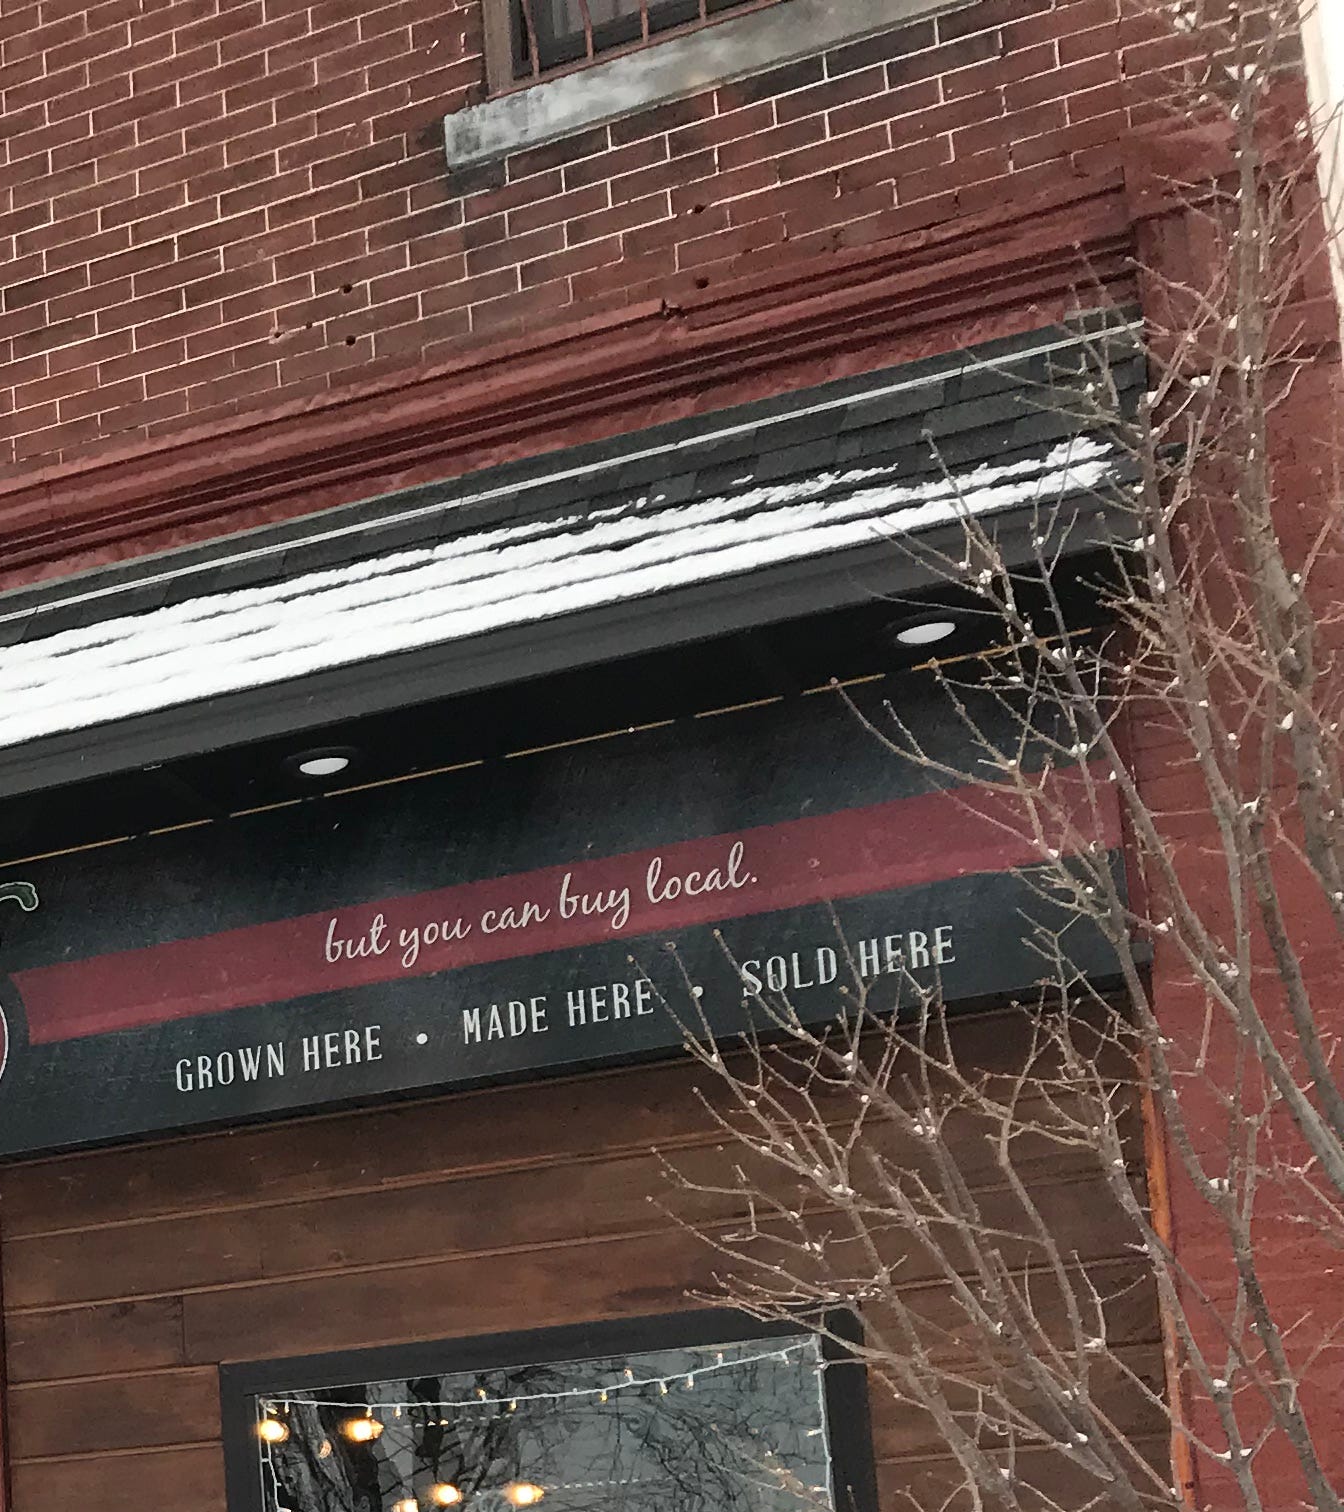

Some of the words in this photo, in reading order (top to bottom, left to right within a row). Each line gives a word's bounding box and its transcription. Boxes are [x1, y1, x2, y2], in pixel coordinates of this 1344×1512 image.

[325, 912, 391, 963] but
[398, 919, 472, 968] you
[481, 898, 550, 934] can
[559, 872, 630, 930] buy
[646, 840, 758, 904] local.
[175, 1041, 285, 1092] GROWN
[303, 1024, 383, 1072] HERE
[462, 996, 549, 1045] MADE
[567, 978, 654, 1027] HERE
[741, 947, 838, 997] SOLD
[858, 925, 956, 978] HERE
